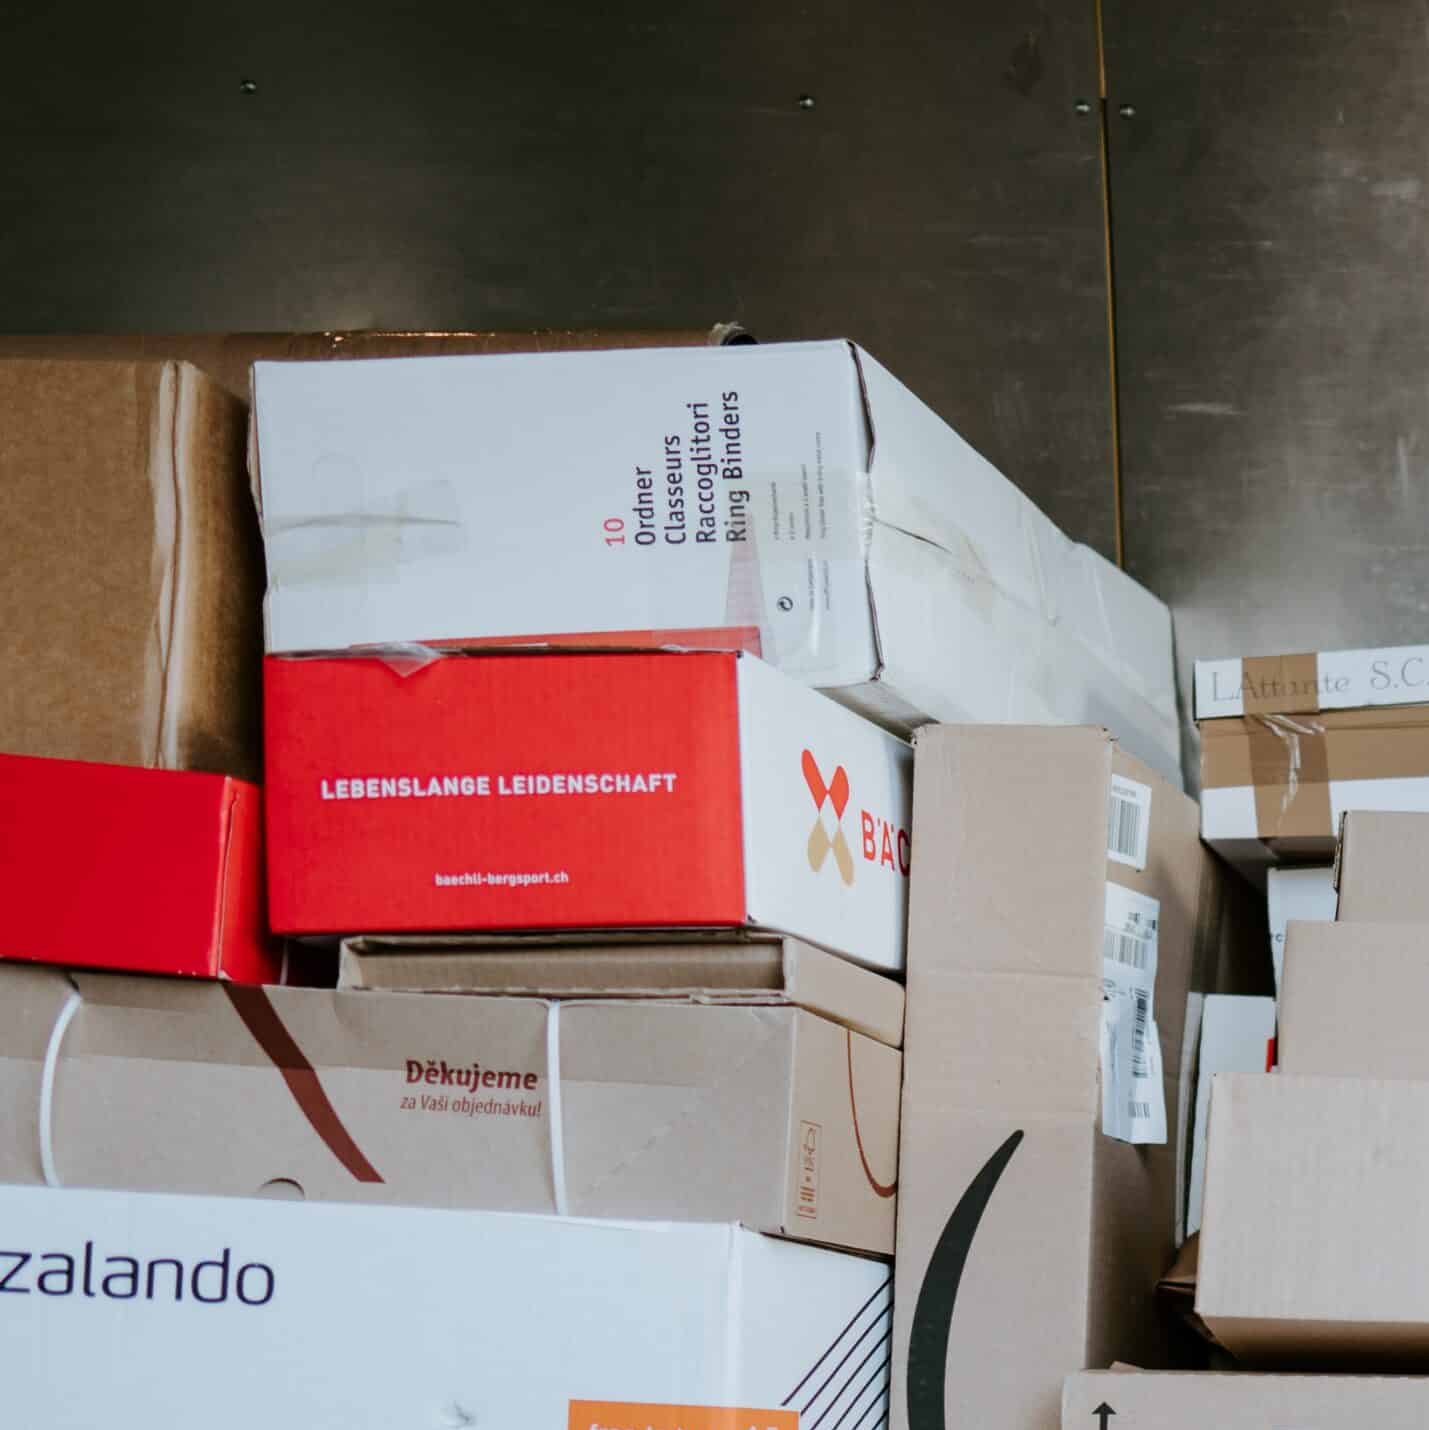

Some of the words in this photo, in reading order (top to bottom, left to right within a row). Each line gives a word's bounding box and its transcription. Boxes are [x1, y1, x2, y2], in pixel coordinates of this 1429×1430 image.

[719, 391, 744, 481] Binders
[663, 435, 687, 544] Classeurs
[686, 402, 719, 544] Raccoglitori
[603, 517, 626, 547] 10
[632, 466, 657, 546] Ordner
[724, 490, 751, 543] Ring
[321, 776, 491, 800] LEBENSLANGE
[497, 773, 677, 797] LEIDENSCHAFT
[399, 1097, 418, 1111] za
[405, 1060, 539, 1093] Děkujeme
[0, 1241, 277, 1307] zalando
